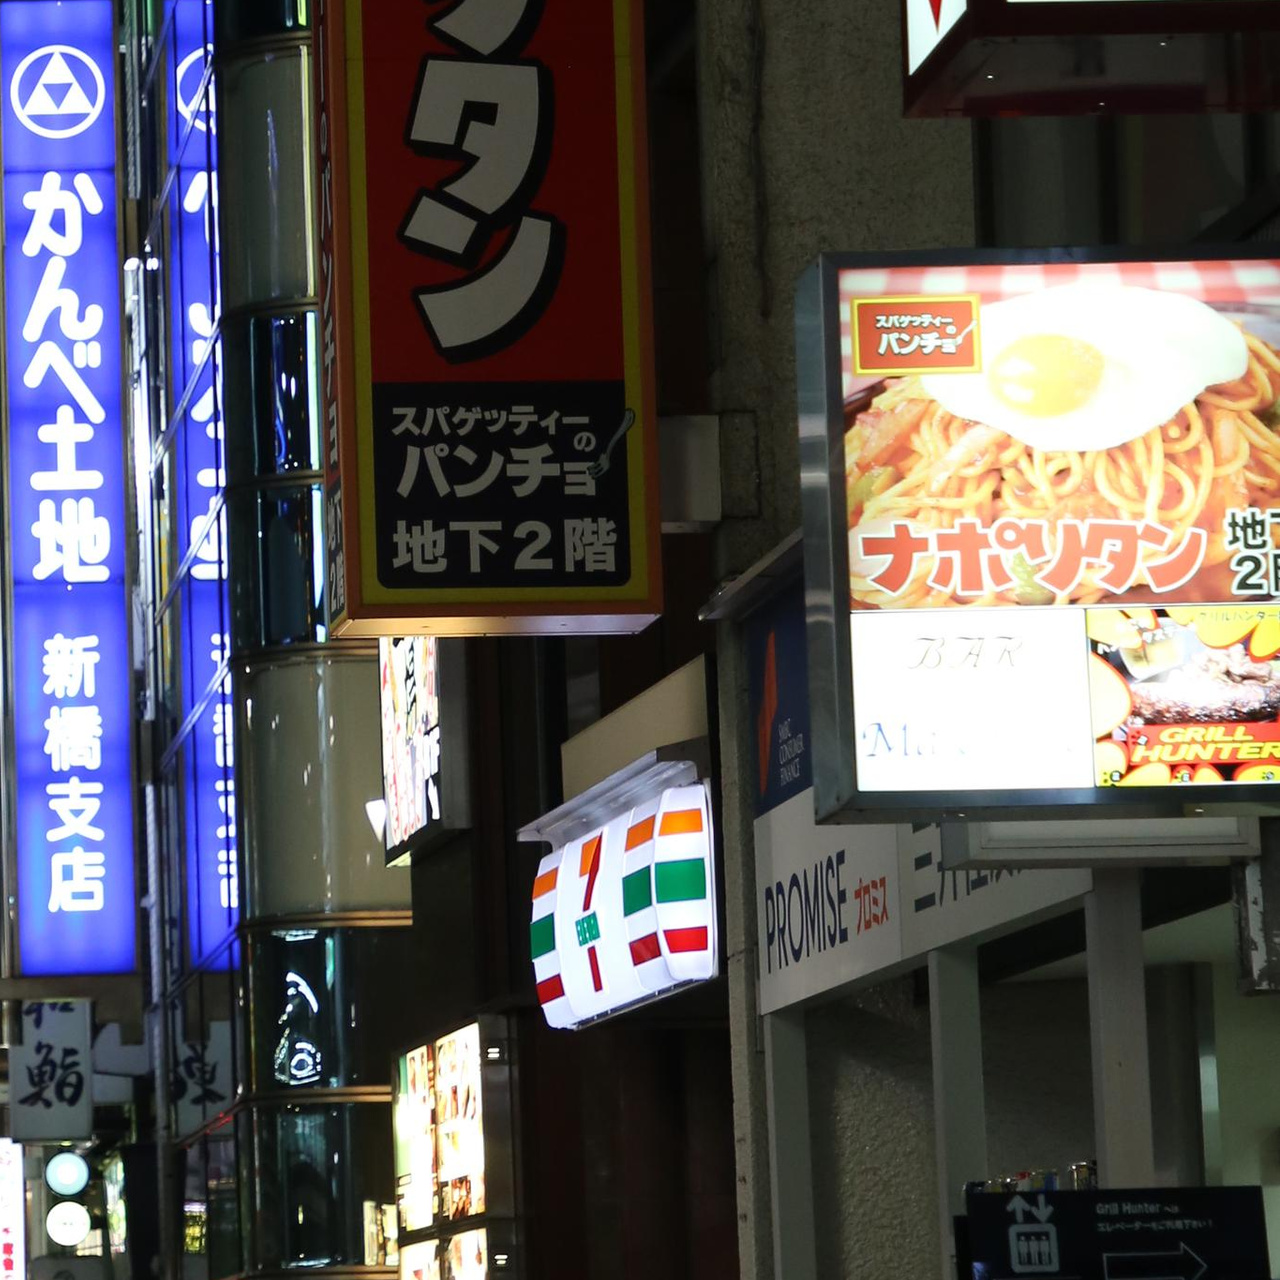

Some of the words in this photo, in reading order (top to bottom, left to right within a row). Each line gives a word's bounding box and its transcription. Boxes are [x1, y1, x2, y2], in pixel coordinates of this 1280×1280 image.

[878, 332, 958, 355] パンチョ
[22, 170, 111, 583] かんべ土地
[391, 405, 590, 437] スパゲッティー
[396, 443, 597, 498] パンチョ
[391, 518, 618, 574] 地下2階
[861, 519, 1208, 596] ナポリタン
[1232, 554, 1280, 596] 2
[1130, 741, 1280, 763] HUNTER
[1159, 725, 1255, 743] GRILL
[43, 632, 107, 914] 新橋支店
[765, 849, 849, 974] PROMISE
[854, 877, 889, 935] プロミス
